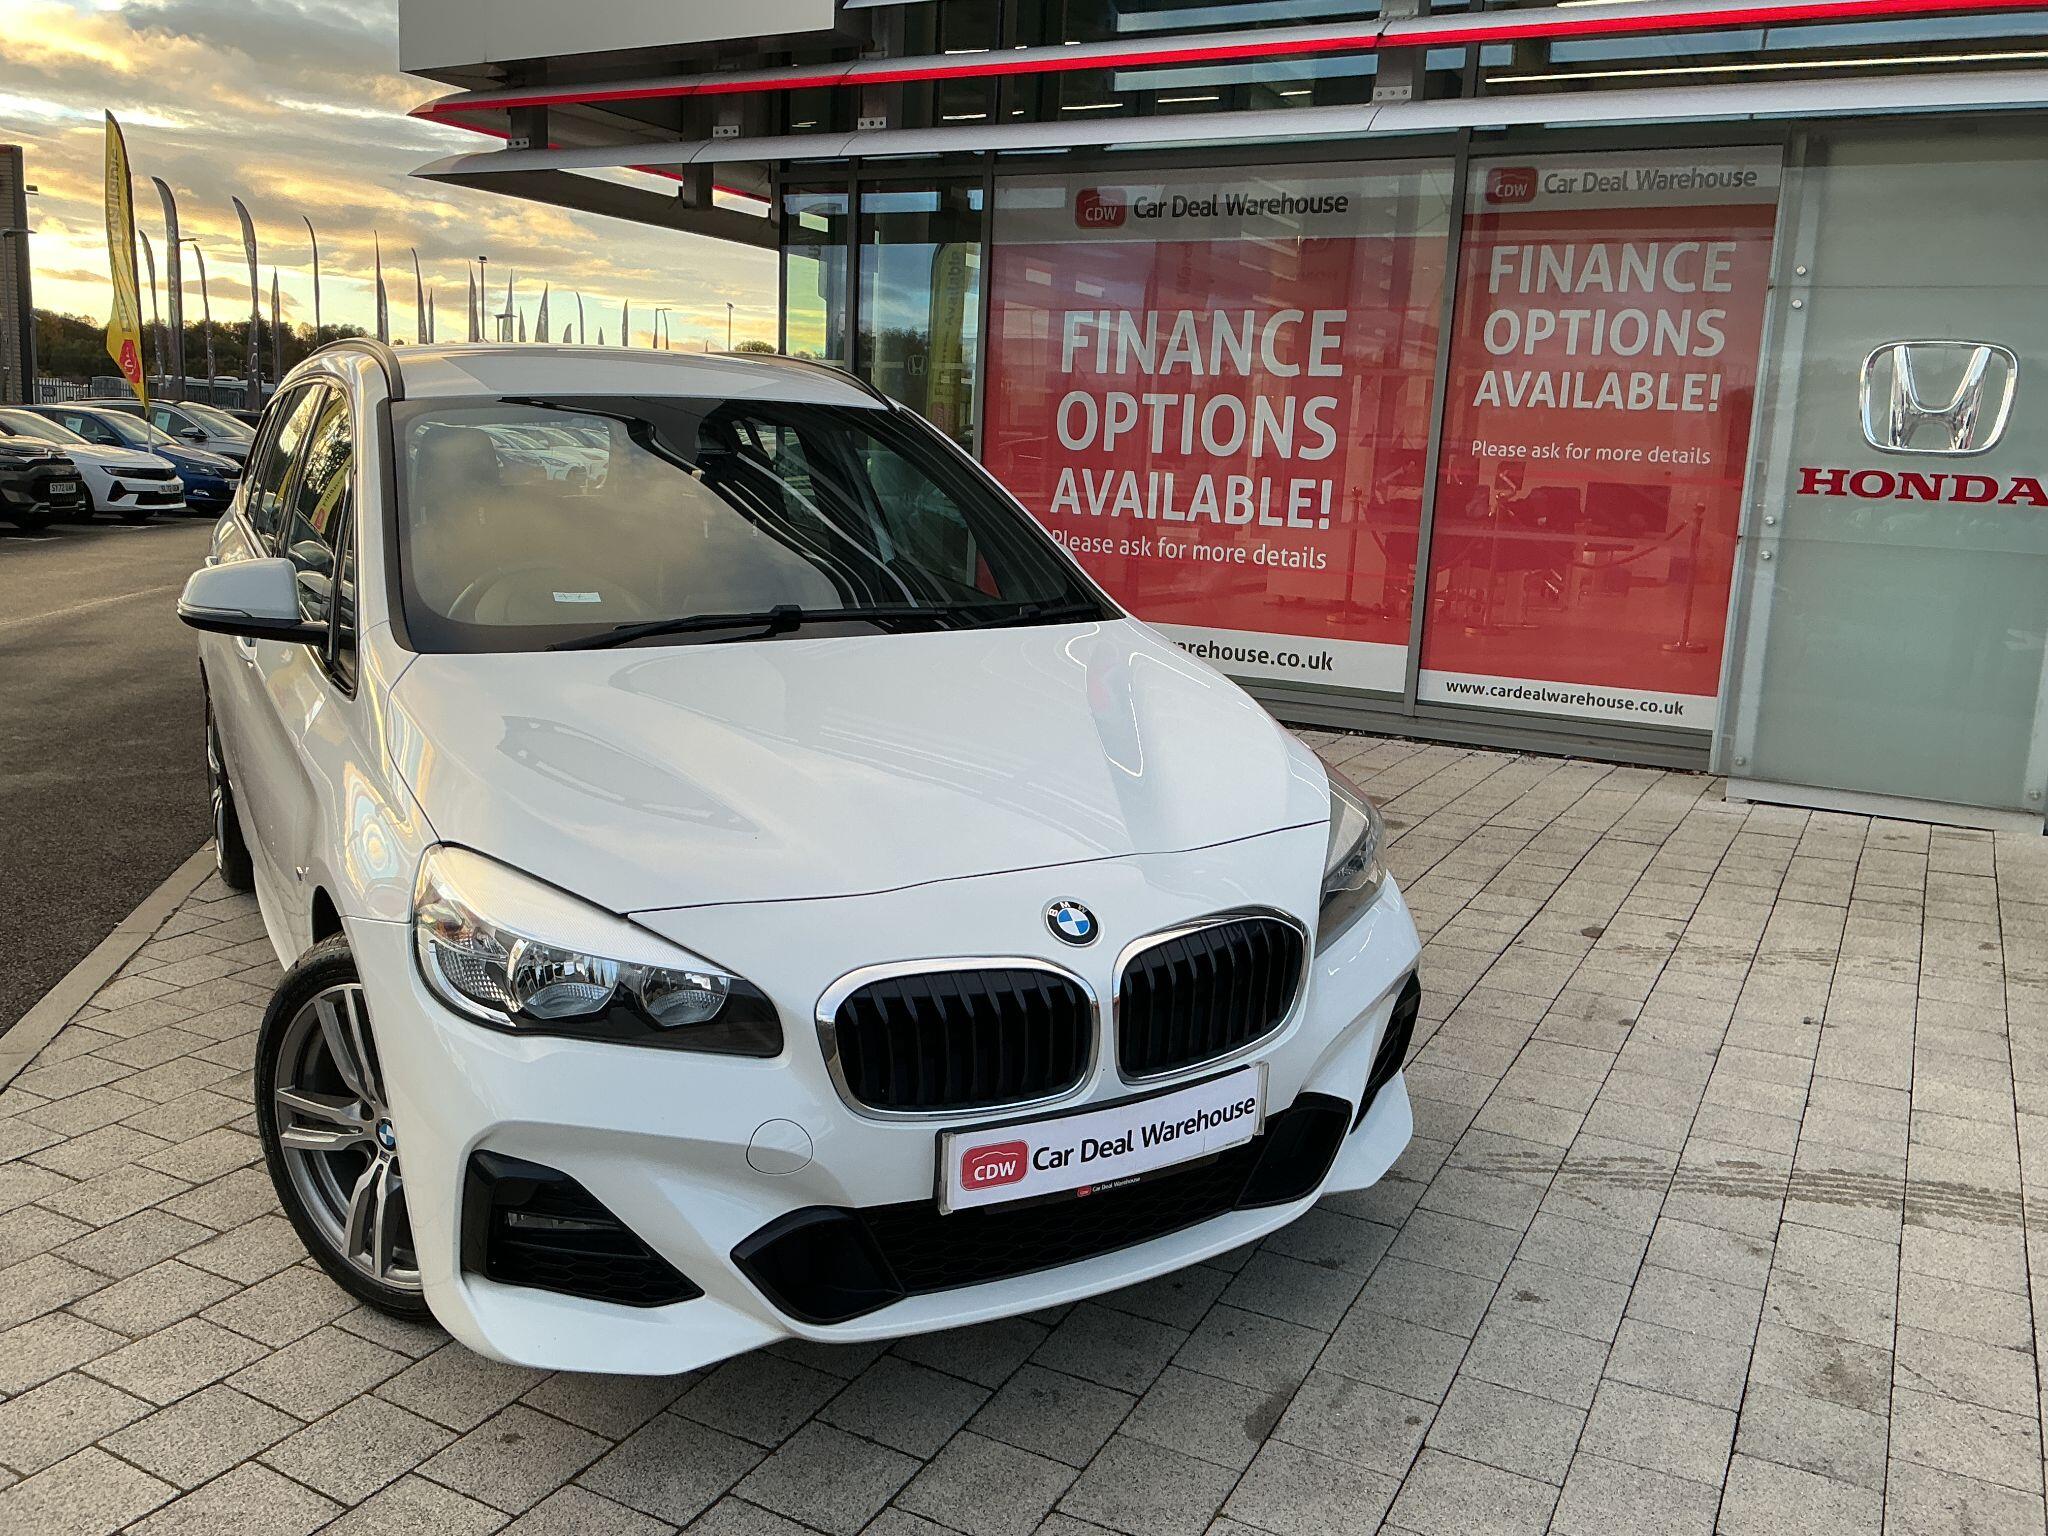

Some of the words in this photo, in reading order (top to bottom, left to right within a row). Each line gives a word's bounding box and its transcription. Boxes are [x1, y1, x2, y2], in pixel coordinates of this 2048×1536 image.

[1495, 183, 1528, 197] CDW
[1544, 173, 1578, 193] Car
[1582, 170, 1628, 193] Deal
[1636, 167, 1758, 192] Warehouse
[1085, 206, 1117, 221] CDW
[1133, 195, 1167, 218] Car
[1171, 194, 1219, 218] Deal
[1225, 191, 1349, 217] Warehouse
[1488, 241, 1737, 294] FINANCE
[1061, 309, 1347, 377] FINANCE
[1483, 308, 1727, 357] OPTIONS
[1472, 370, 1721, 412] AVAILABLE!
[1056, 390, 1338, 460] OPTIONS
[1471, 440, 1527, 458] Please
[1531, 442, 1559, 459] ask
[1565, 443, 1591, 460] for
[1595, 446, 1642, 462] more
[1648, 446, 1711, 465] details
[1050, 467, 1333, 530] AVAILABLE!
[1796, 467, 2048, 507] HONDA
[1051, 529, 1114, 554] Please
[1119, 536, 1151, 557] ask
[1157, 537, 1187, 560] for
[1192, 544, 1246, 564] more
[1253, 544, 1327, 570] details
[1172, 640, 1333, 671] arehouse.co.uk
[1446, 680, 1684, 716] www.cardealwarehouse.co.uk
[1048, 901, 1088, 917] BMW
[974, 1159, 1016, 1182] CDW
[1032, 1146, 1075, 1171] Car
[1080, 1129, 1134, 1163] Deal
[1141, 1097, 1256, 1148] Warehouse
[1101, 1182, 1113, 1190] Deal
[1113, 1177, 1141, 1187] Warehouse
